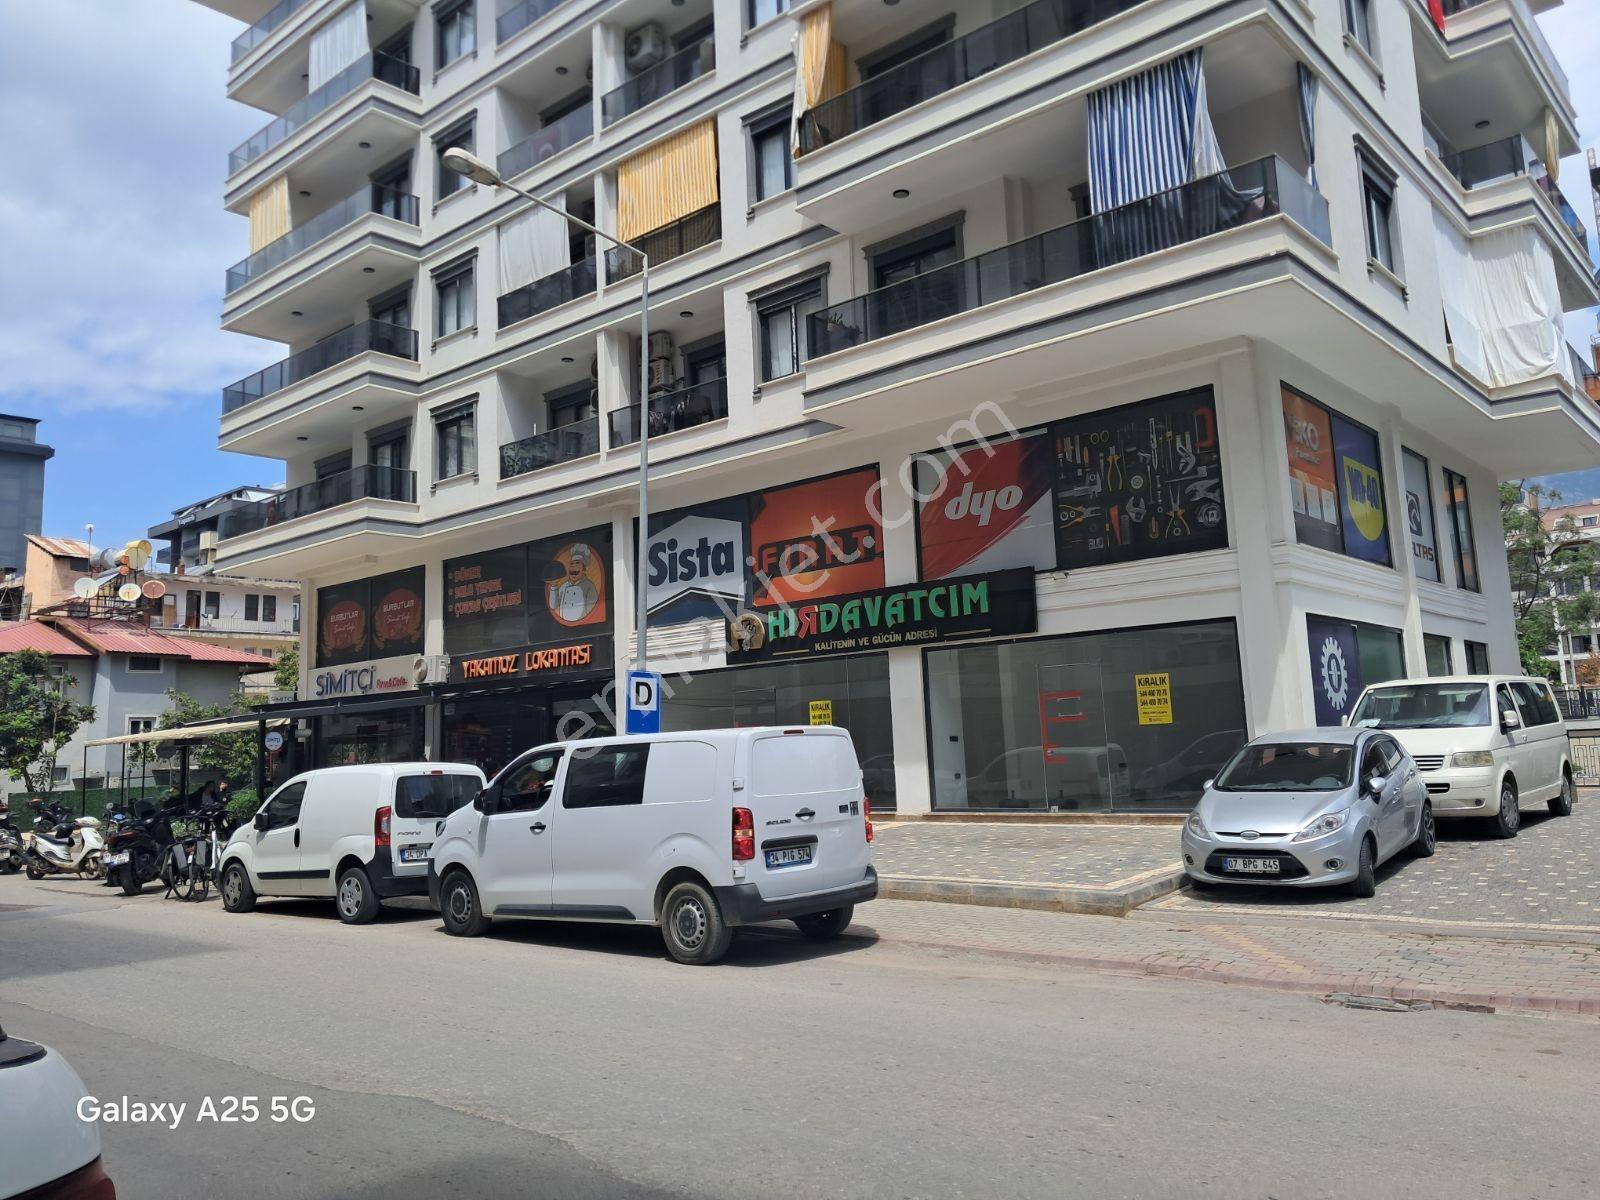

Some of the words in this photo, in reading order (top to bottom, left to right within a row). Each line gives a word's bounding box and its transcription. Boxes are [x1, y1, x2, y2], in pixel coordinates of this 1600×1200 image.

[944, 483, 1024, 527] dyo
[648, 537, 735, 587] Sista
[858, 635, 870, 647] VE
[904, 627, 938, 640] ADRESİ
[461, 653, 520, 679] YAKAMOZ
[525, 643, 593, 672] LOKANTASI
[315, 665, 376, 697] SİMİTÇİ
[635, 681, 652, 706] D
[771, 852, 779, 862] 34
[782, 850, 795, 861] PIG
[797, 846, 810, 860] 574
[1228, 860, 1238, 868] 07
[1242, 860, 1258, 869] BPG
[1262, 860, 1279, 869] 645
